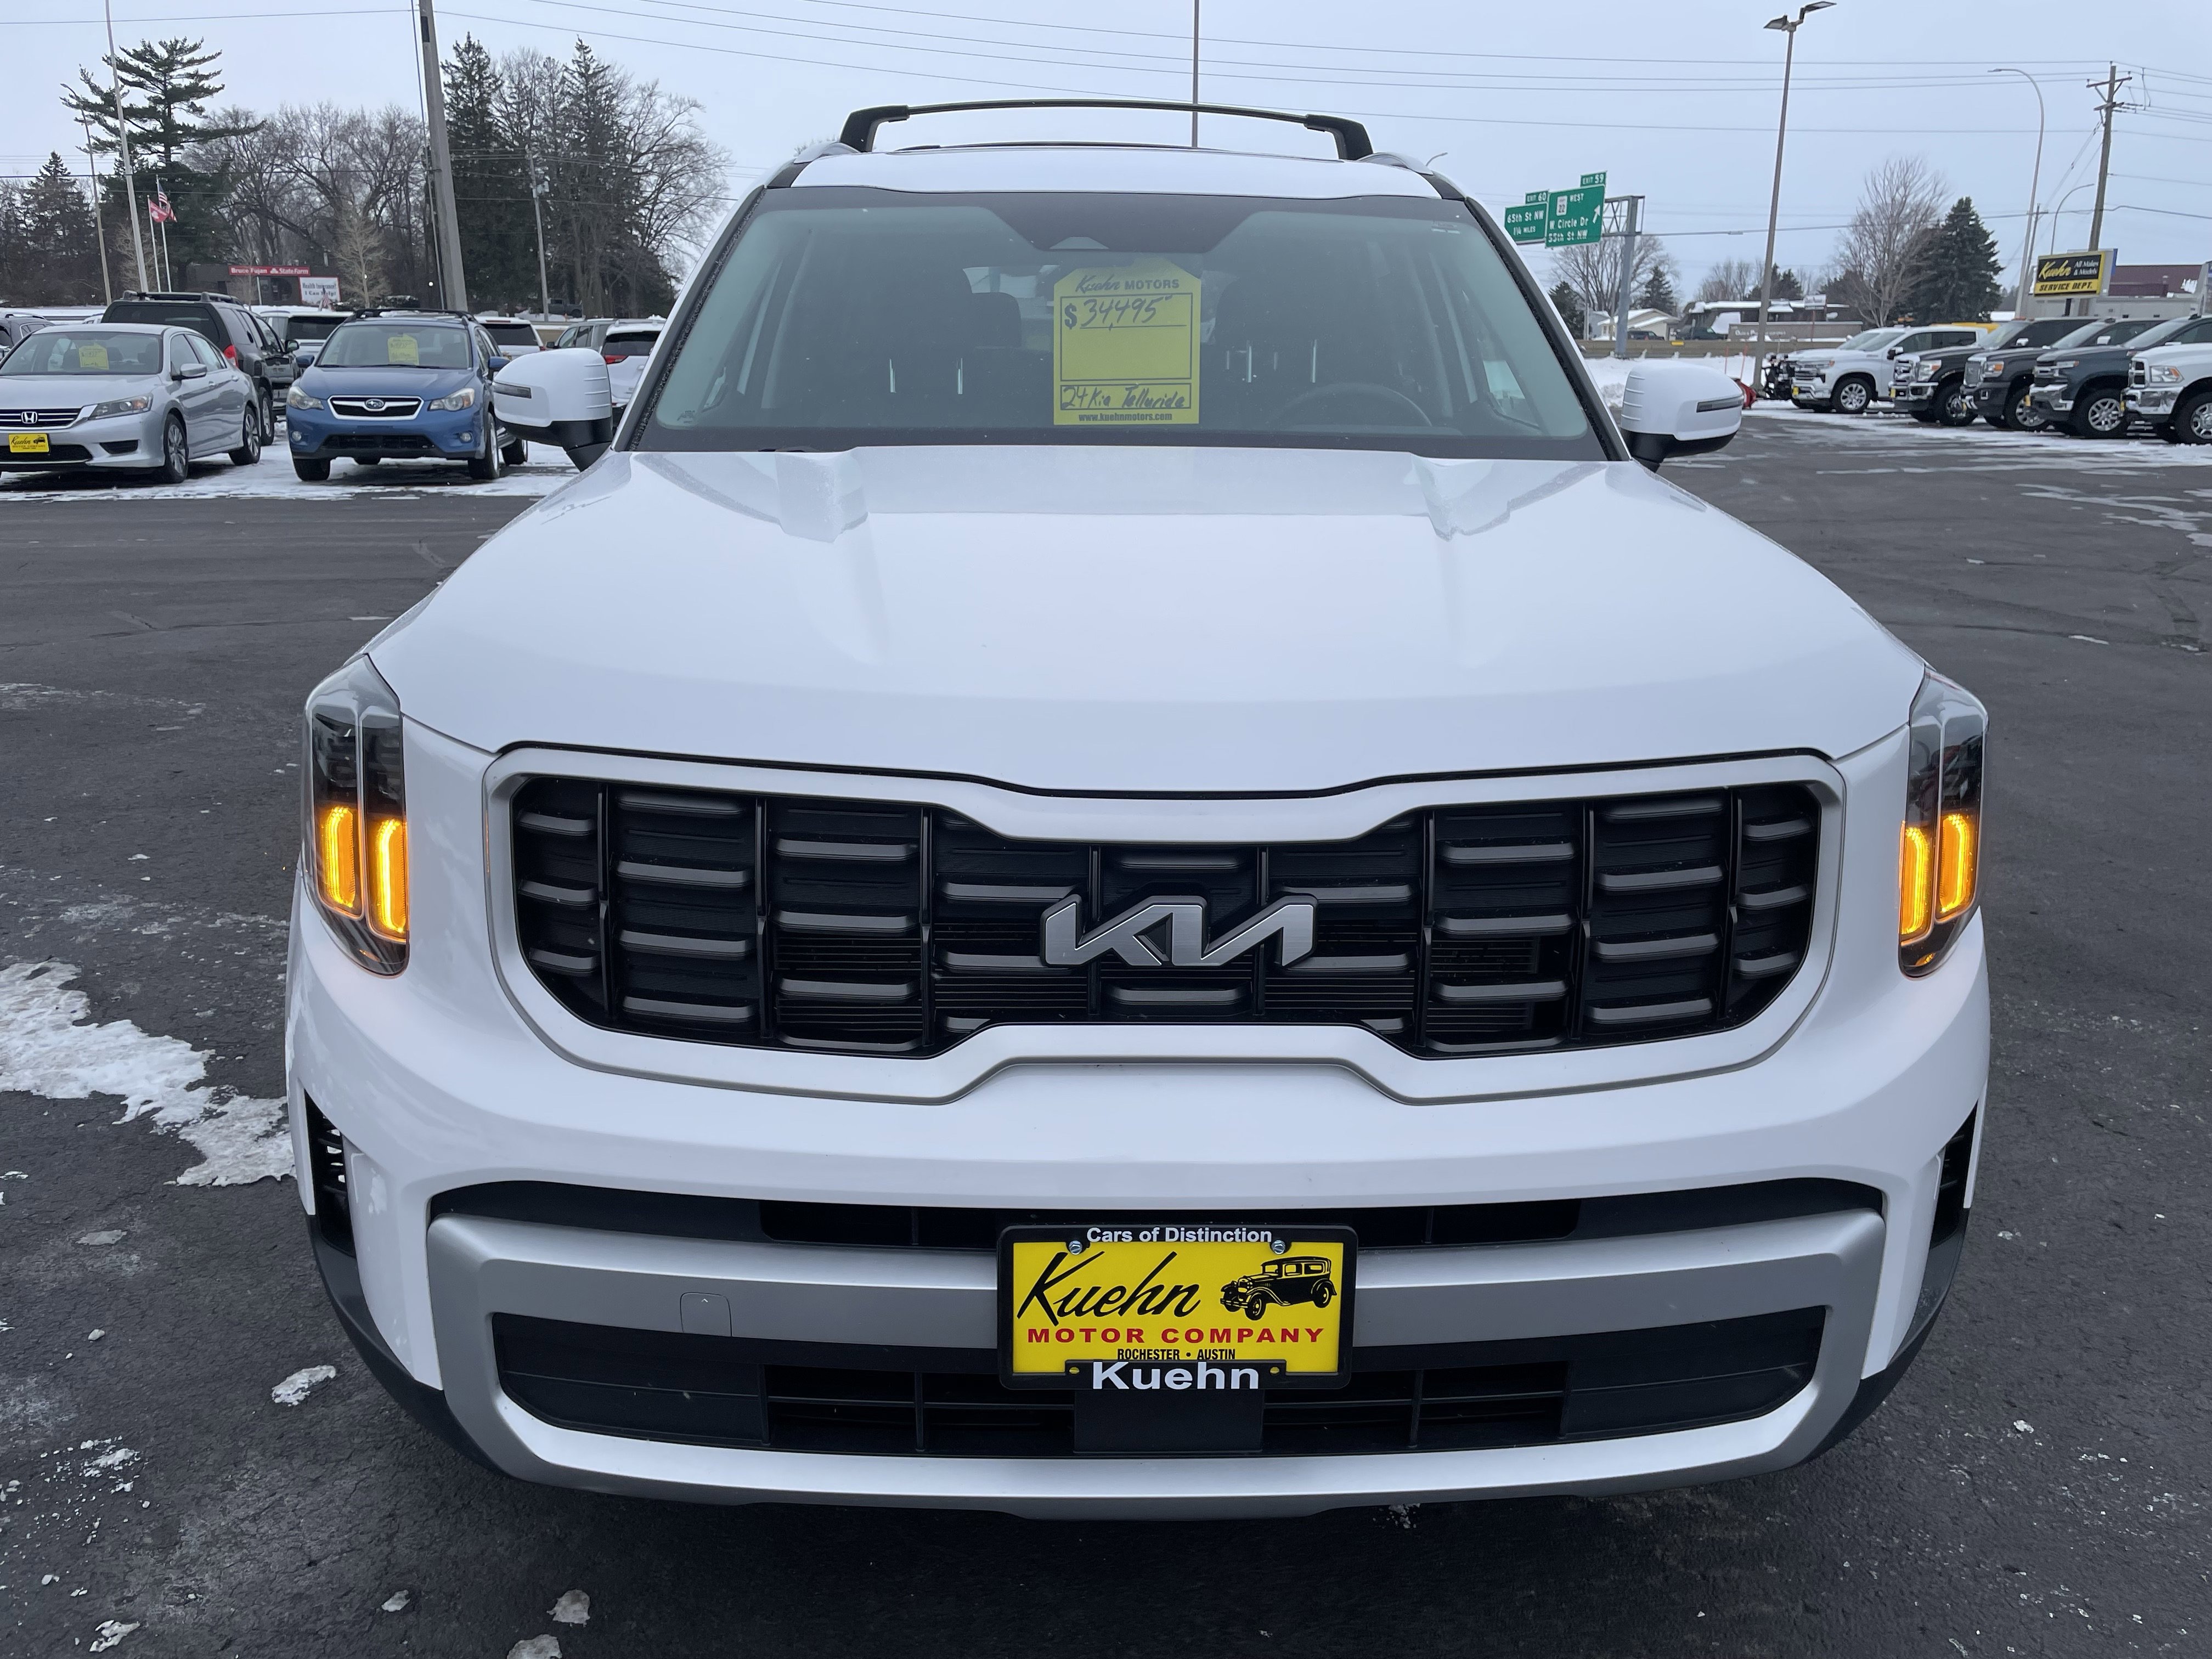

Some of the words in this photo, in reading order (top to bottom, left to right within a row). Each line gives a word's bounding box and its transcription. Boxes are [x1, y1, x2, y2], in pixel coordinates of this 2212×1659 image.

[1595, 174, 1604, 184] 59
[1538, 192, 1547, 201] 60
[1570, 193, 1584, 202] WEST
[1558, 204, 1565, 213] 22
[1507, 213, 1522, 223] 65th
[1525, 212, 1532, 221] St
[1534, 210, 1544, 220] NW
[1549, 220, 1555, 229] W
[1558, 218, 1577, 229] Circle
[1580, 216, 1588, 227] Dr
[1548, 233, 1564, 243] 55th
[1567, 231, 1575, 241] St
[1577, 229, 1588, 240] NW
[2039, 260, 2072, 280] Kuehn
[1075, 274, 1120, 294] Kuehn
[1125, 279, 1180, 290] MOTORS
[2039, 283, 2070, 291] SERVICE
[1087, 387, 1111, 409] Kia
[1122, 385, 1185, 409] Telluride
[1079, 413, 1172, 422] www.kuehnmotors.com
[1042, 894, 1317, 967] KIA
[1087, 1227, 1133, 1243] Cars
[1139, 1227, 1160, 1243] of
[1165, 1227, 1272, 1243] Distinction
[1017, 1251, 1201, 1327] Kuehn
[1028, 1328, 1145, 1343] MOTOR
[1161, 1328, 1324, 1343] COMPANY
[1117, 1348, 1180, 1360] ROCHESTER
[1197, 1348, 1235, 1360] AUSTIN
[1093, 1361, 1259, 1389] Kuehn
